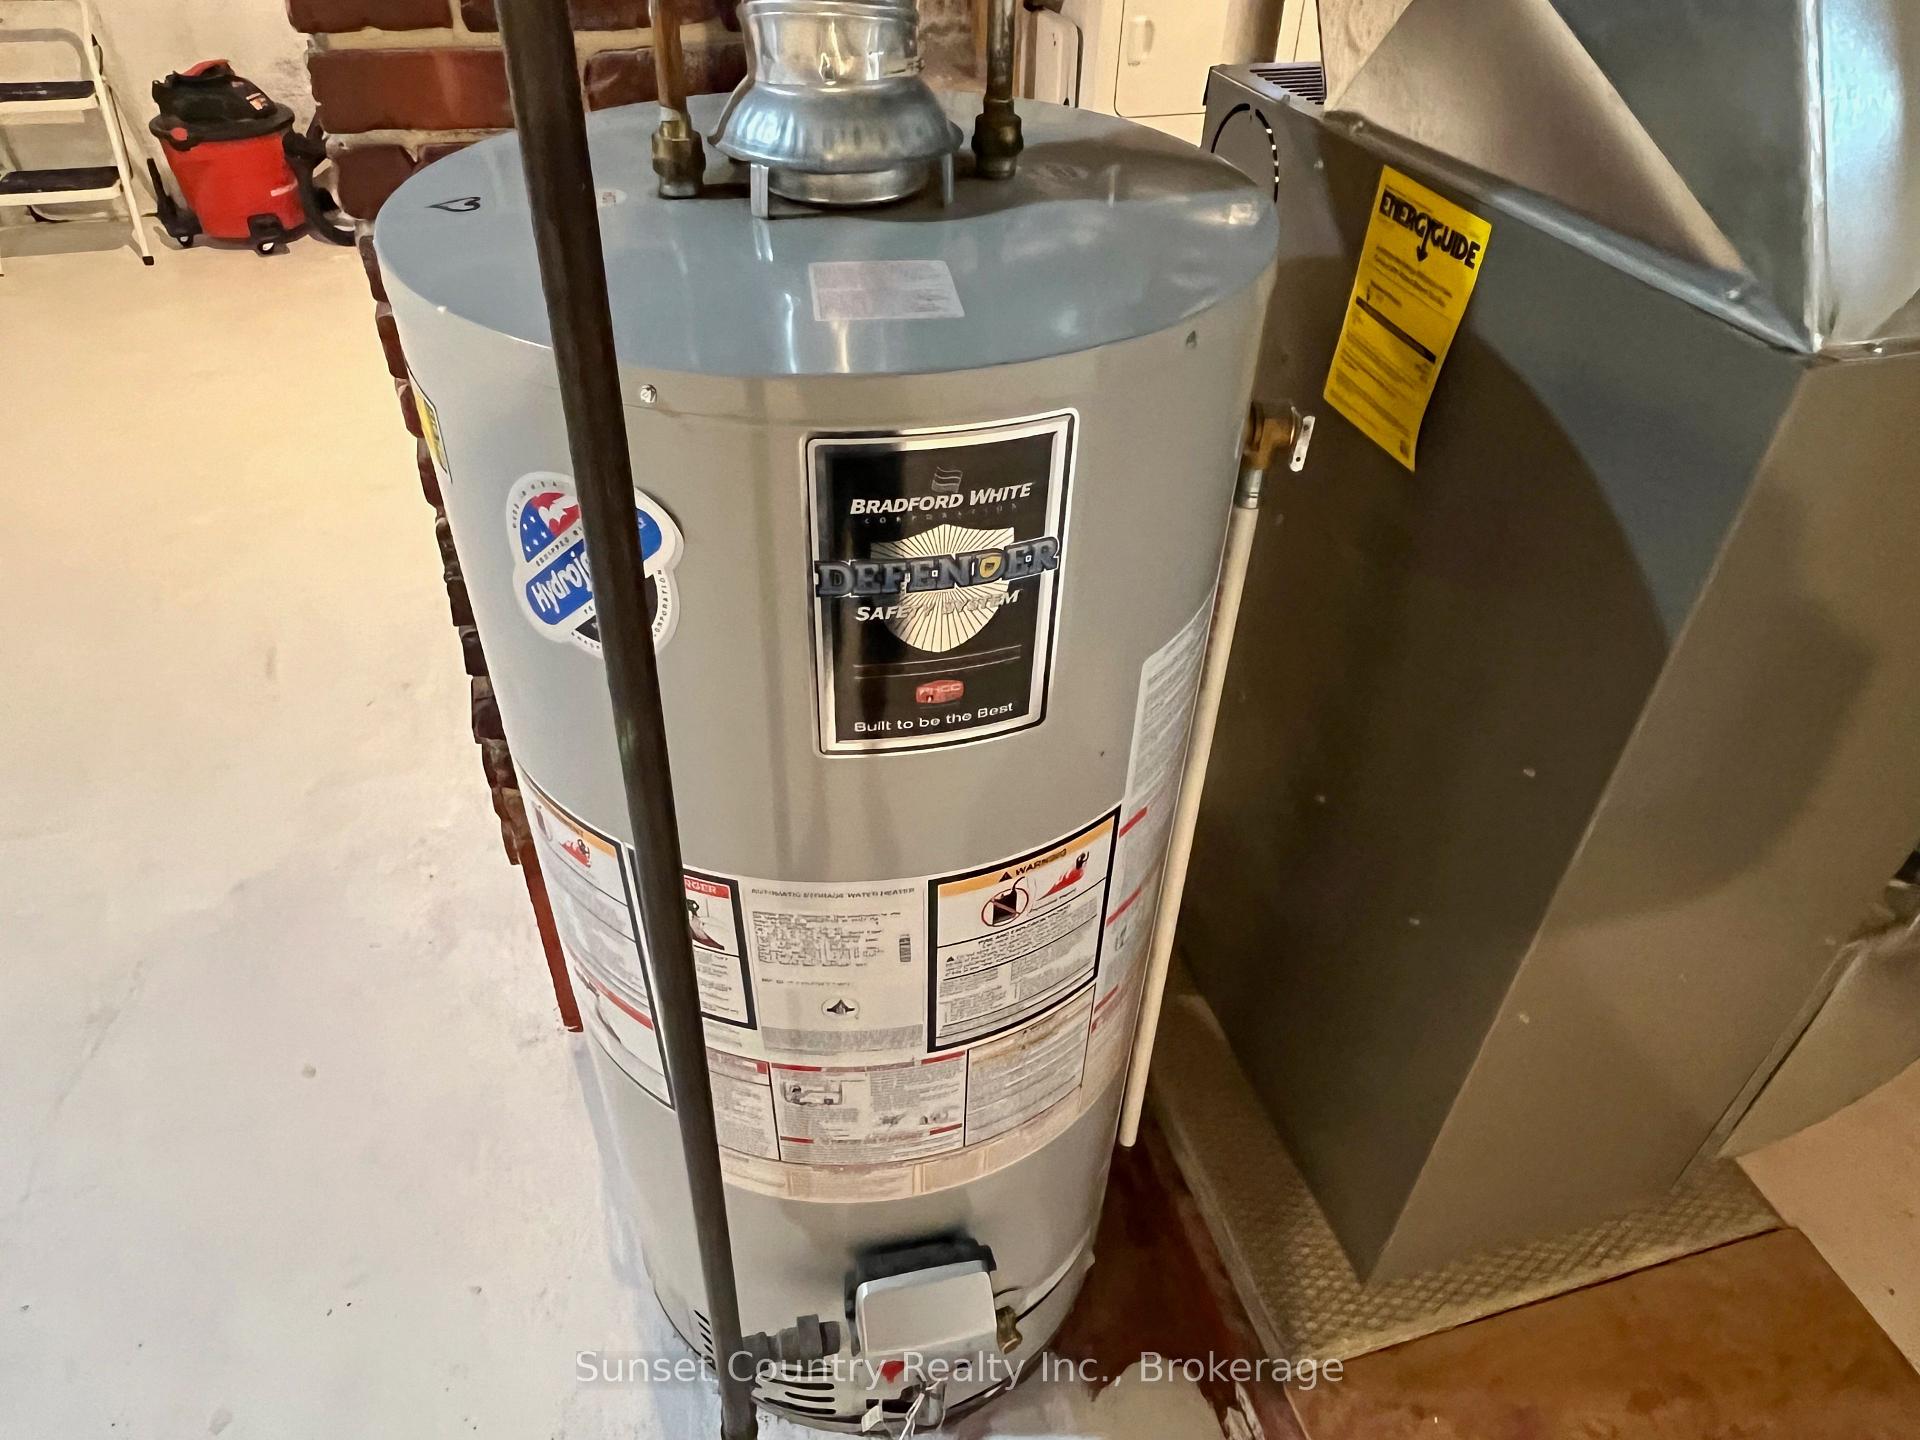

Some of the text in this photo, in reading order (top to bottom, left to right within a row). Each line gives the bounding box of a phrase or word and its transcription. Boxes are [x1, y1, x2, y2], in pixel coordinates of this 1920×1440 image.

[850, 482, 1034, 515] BRADFORD WHITE
[814, 536, 1060, 597] DEFENDER
[855, 589, 1022, 622] SAFETY SYSTEM
[854, 702, 1013, 732] Built to be the Best
